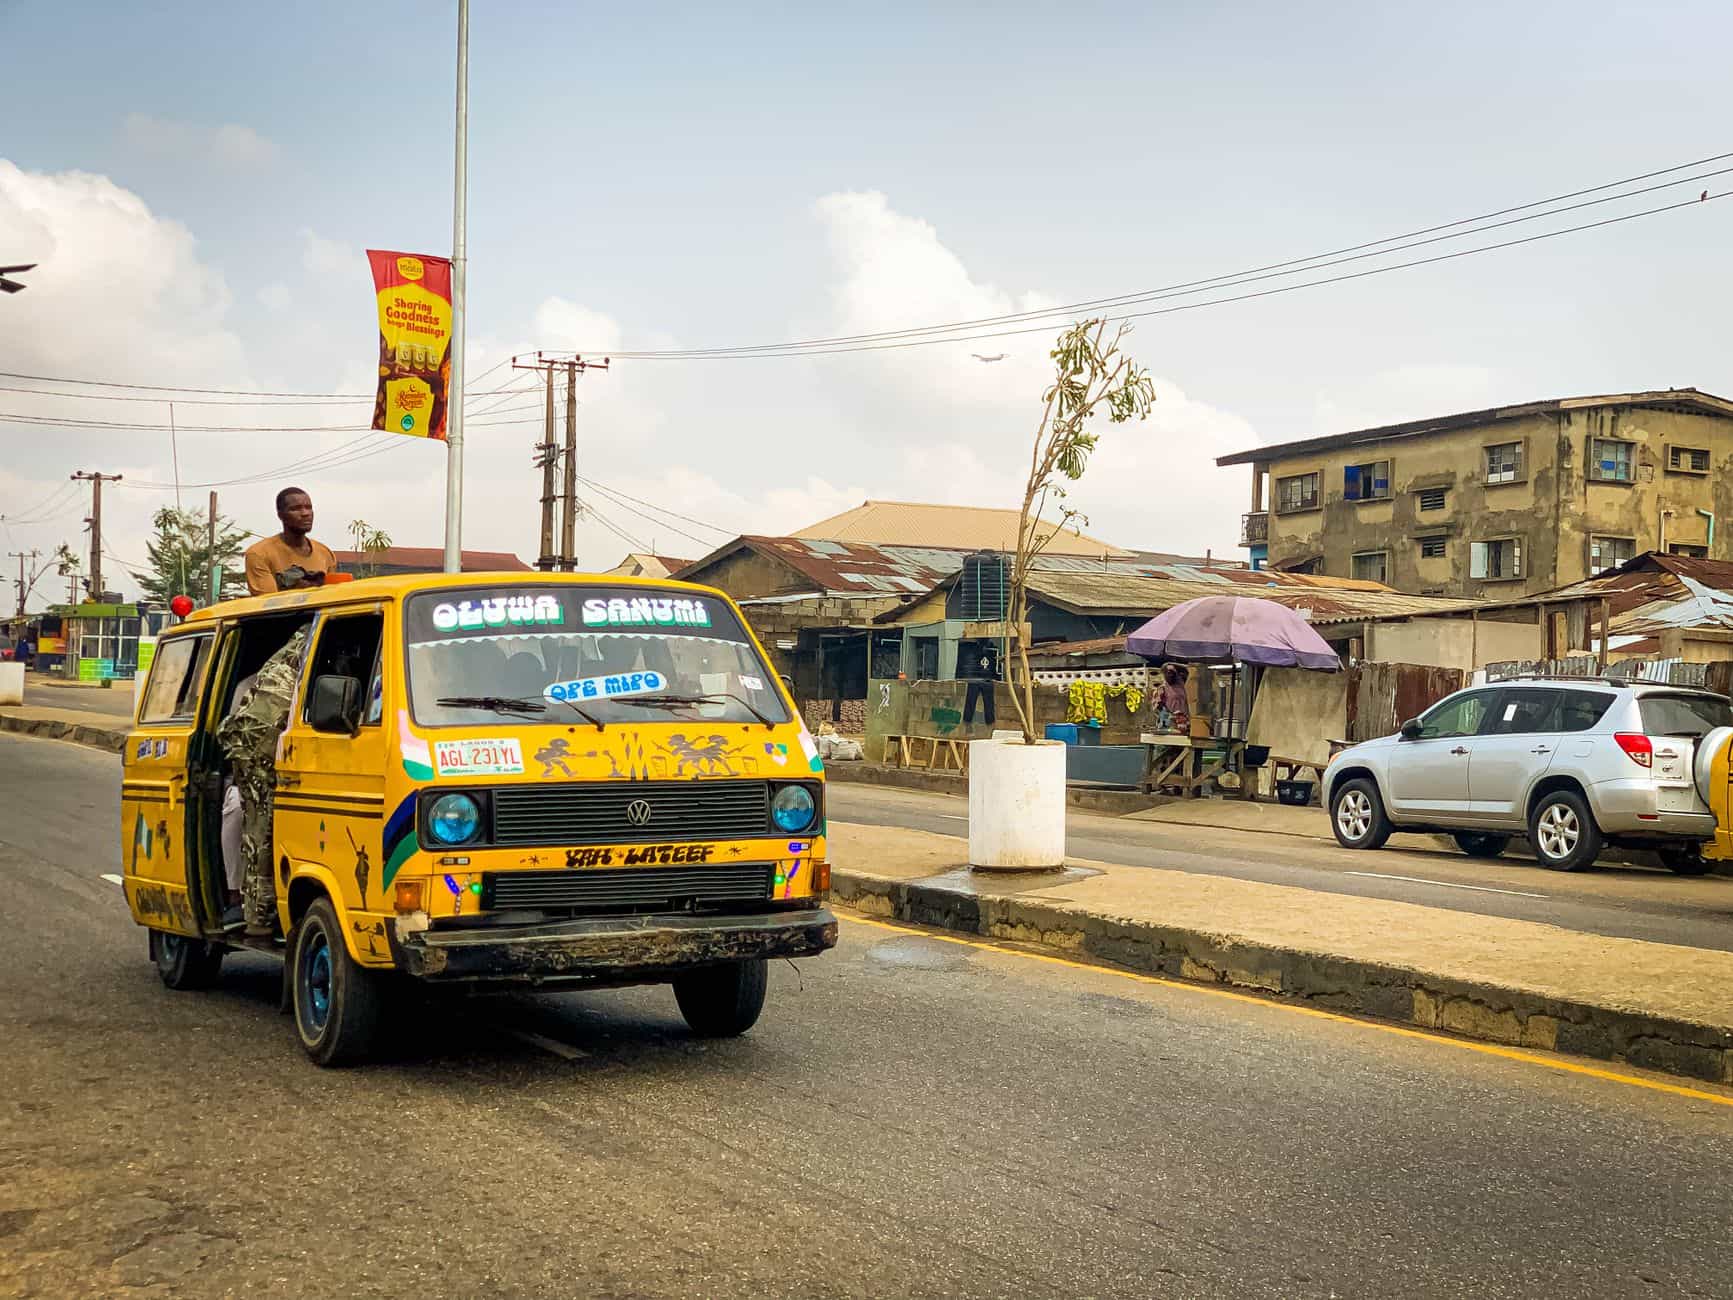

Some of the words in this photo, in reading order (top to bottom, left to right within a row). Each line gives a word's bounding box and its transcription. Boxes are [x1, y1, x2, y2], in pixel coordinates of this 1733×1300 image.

[385, 306, 440, 326] Goodness
[394, 298, 433, 315] Sharing
[406, 322, 445, 339] Blessings
[433, 596, 563, 631] OLUWA
[551, 680, 598, 700] OPE
[441, 749, 469, 767] AGL
[624, 845, 715, 865] LATEEF
